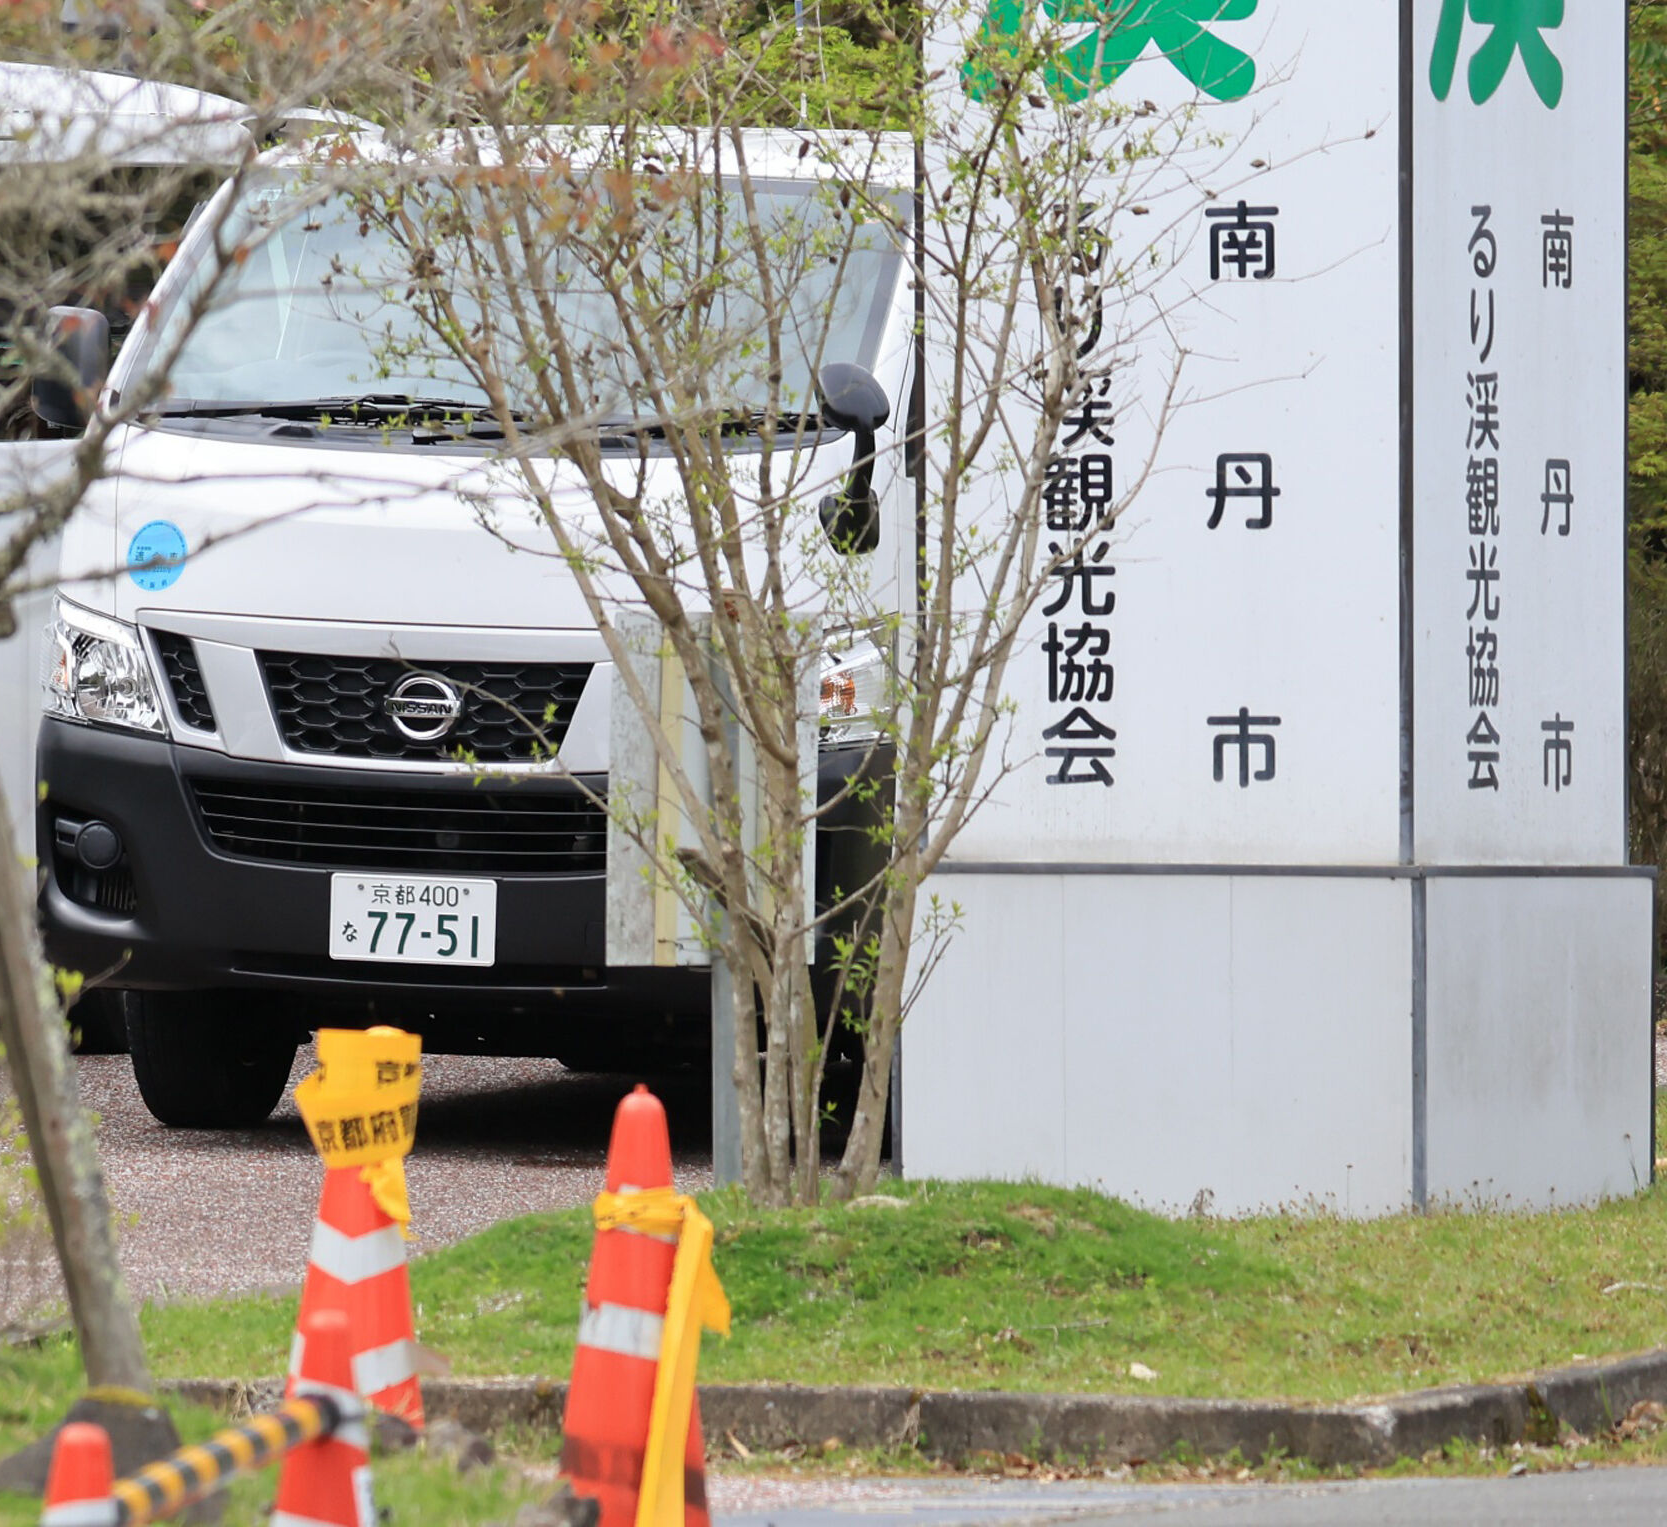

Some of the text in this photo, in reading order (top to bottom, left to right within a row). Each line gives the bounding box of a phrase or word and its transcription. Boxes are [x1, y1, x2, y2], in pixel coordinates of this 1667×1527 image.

[1204, 200, 1282, 788] 南丹市
[1466, 205, 1501, 793] るり渓観光協会
[1540, 209, 1575, 794] 南丹市
[391, 702, 453, 715] NISSAN
[370, 883, 459, 907] 京都400
[341, 920, 358, 943] な
[367, 910, 479, 959] 77-51
